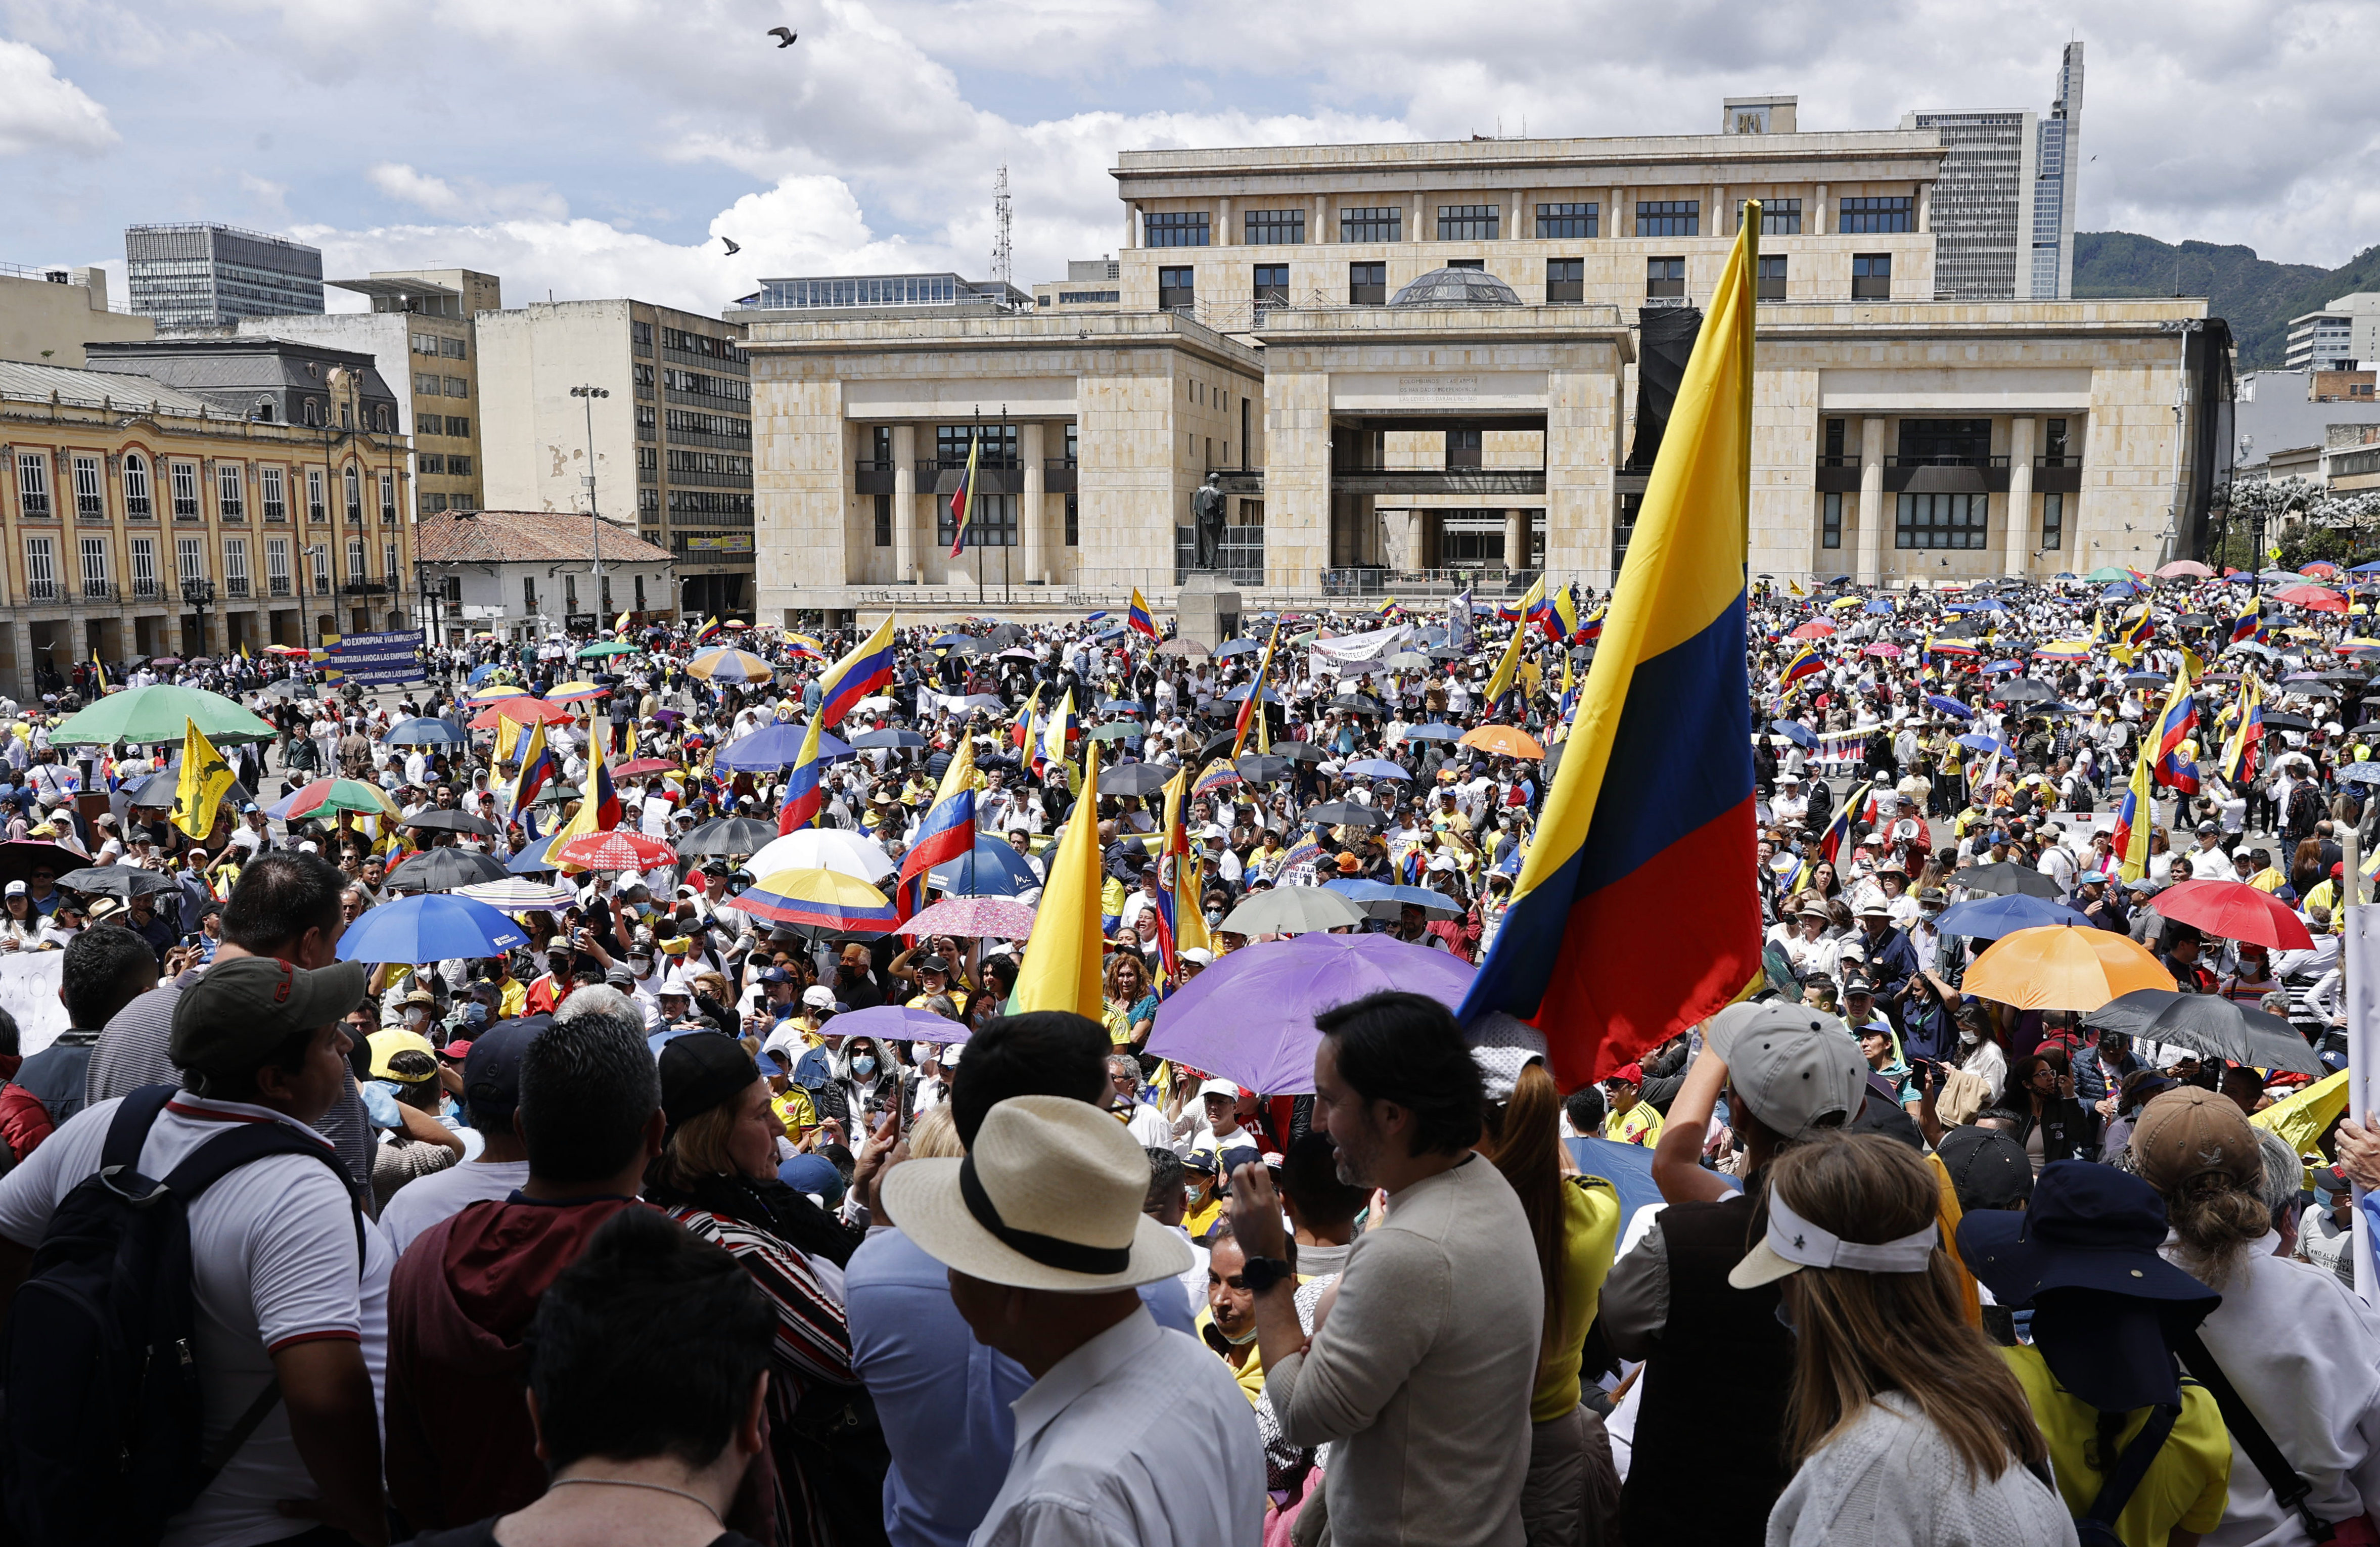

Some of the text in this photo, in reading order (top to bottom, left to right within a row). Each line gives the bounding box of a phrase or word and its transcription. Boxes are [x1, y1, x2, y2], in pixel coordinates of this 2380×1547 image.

[342, 638, 351, 647] NO
[351, 635, 383, 646] EXPROPIAR
[384, 634, 393, 644] VIA
[330, 651, 414, 664] TRIBUTARIA AHOGA LAS EMPRESAS
[1338, 648, 1375, 659] PROTECCION
[374, 670, 391, 678] AHOGA
[392, 669, 401, 677] LAS
[401, 667, 425, 677] EMPRESAS
[2323, 1260, 2350, 1272] PETRISTA
